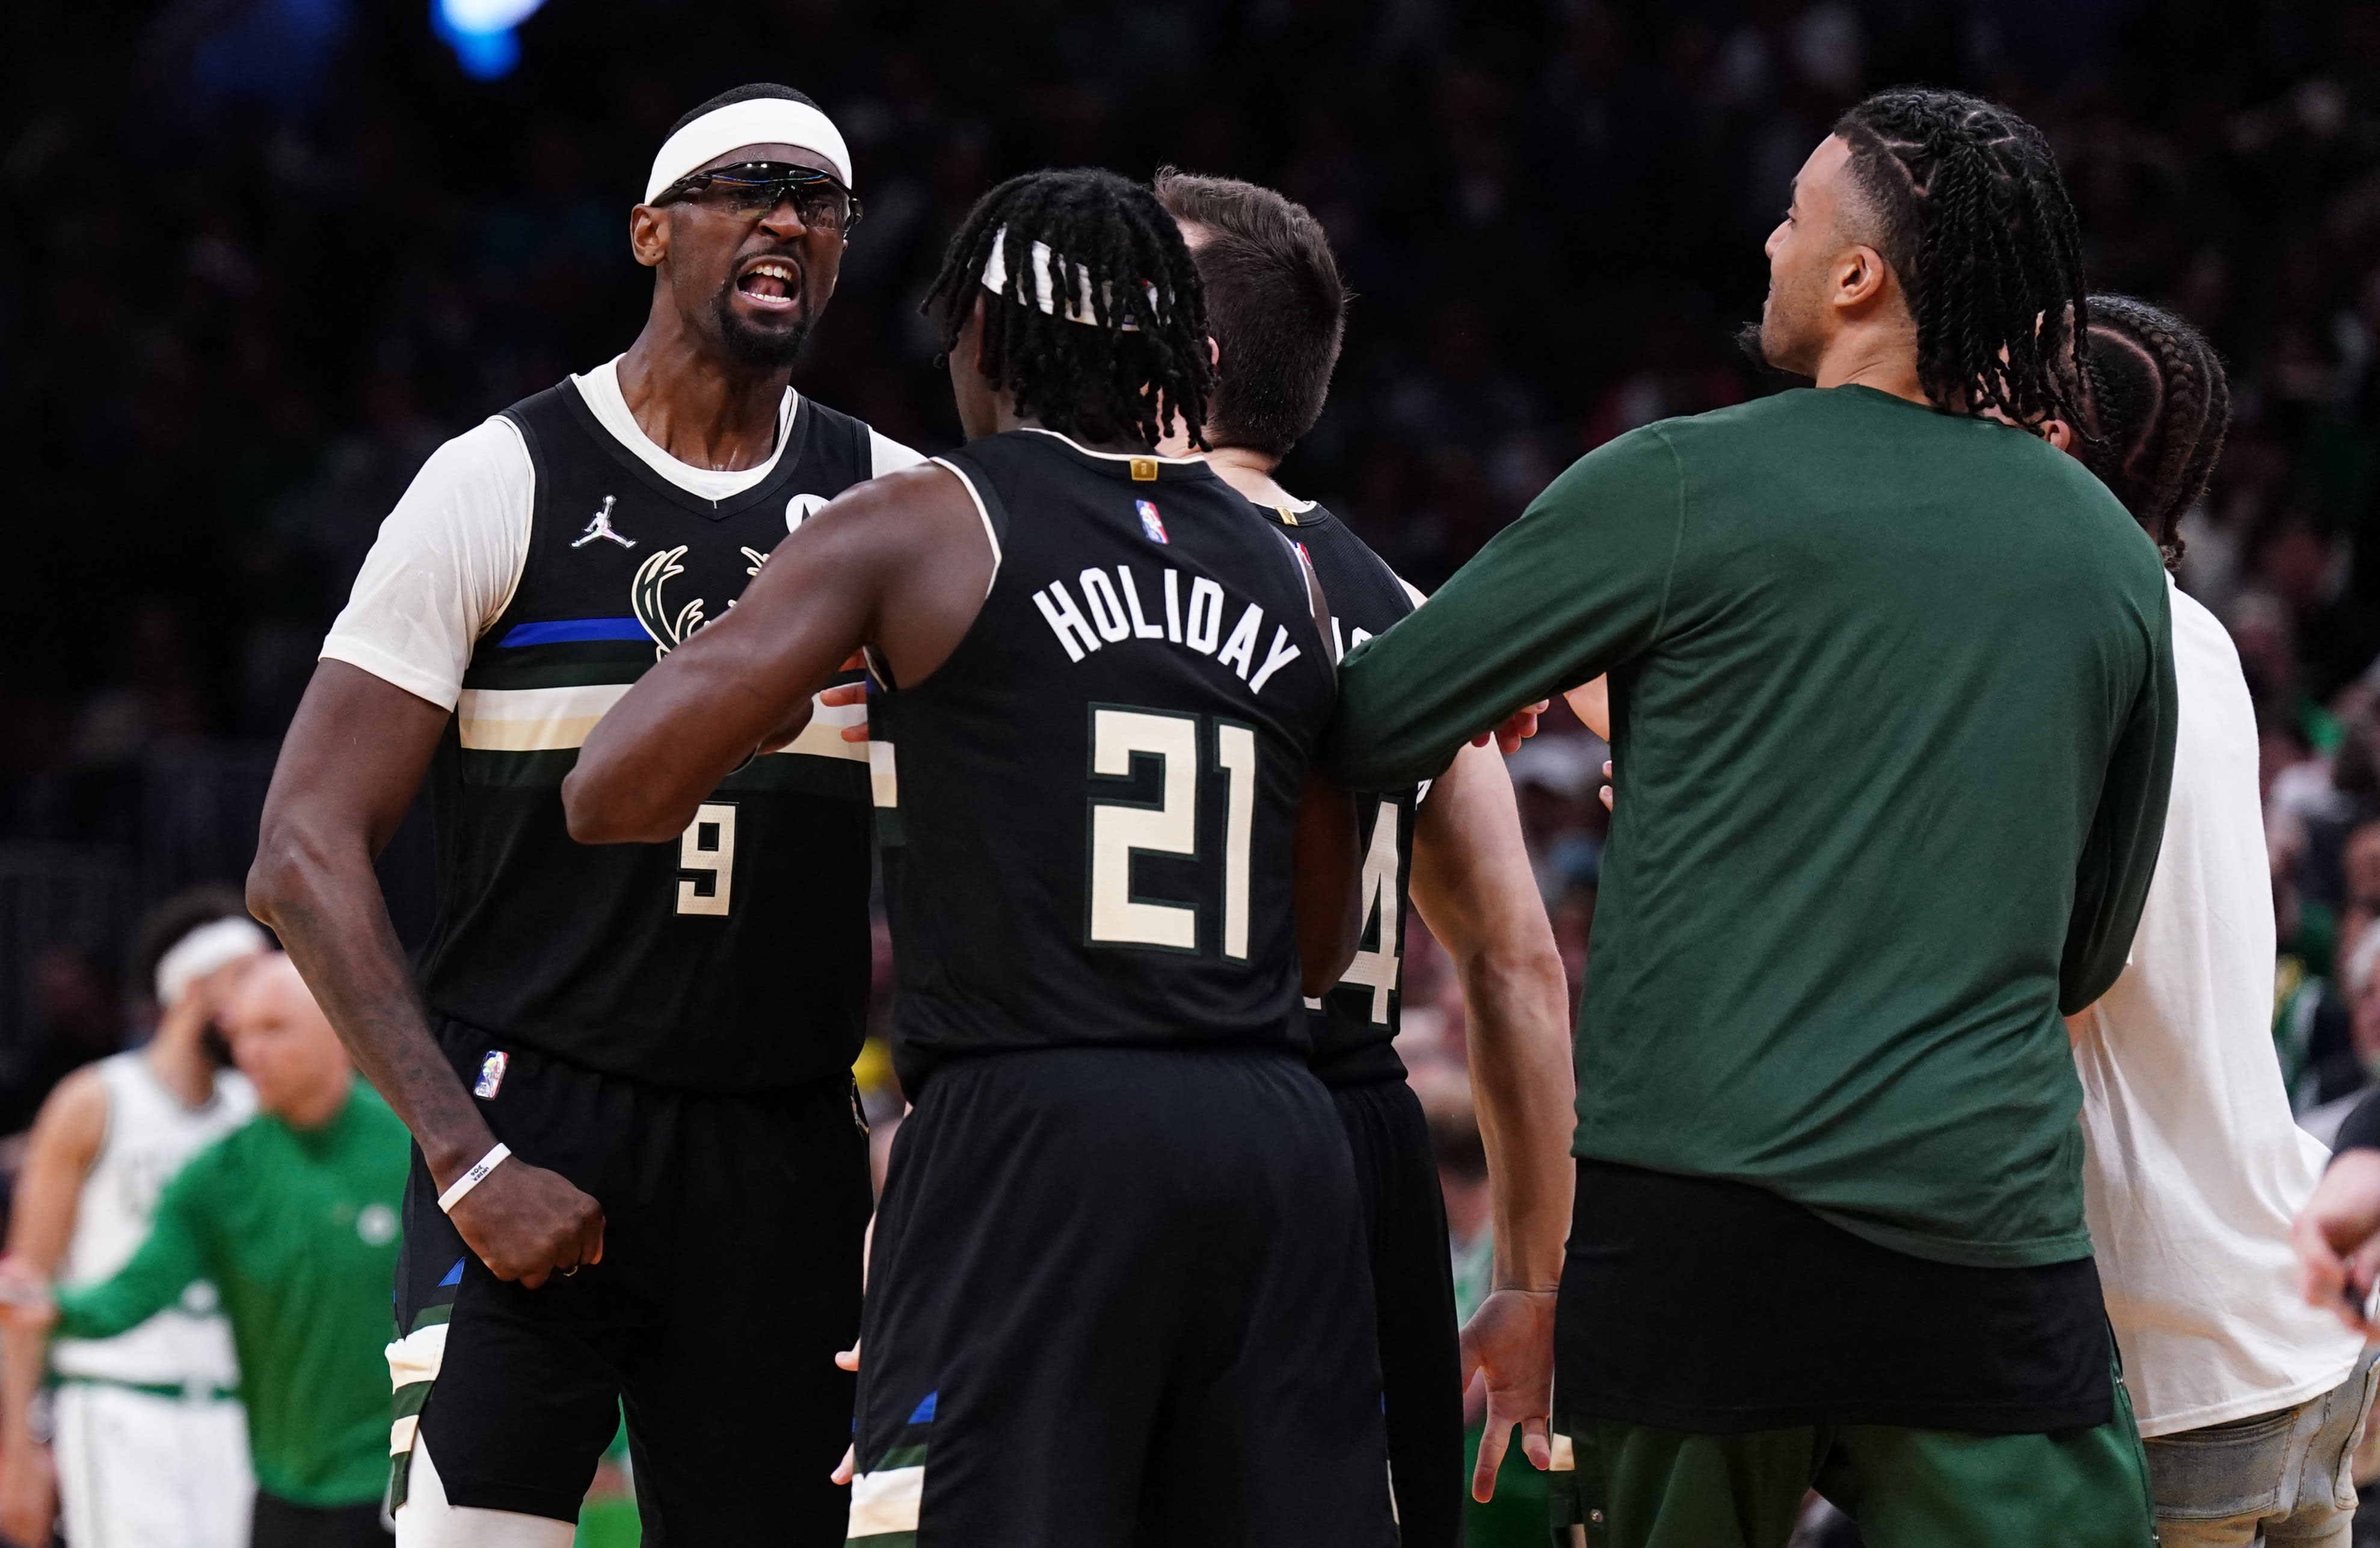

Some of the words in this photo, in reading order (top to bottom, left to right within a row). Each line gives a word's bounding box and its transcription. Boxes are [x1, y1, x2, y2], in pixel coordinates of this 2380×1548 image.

[1032, 565, 1302, 695] HOLIDAY
[676, 803, 736, 916] 9
[1090, 708, 1256, 960] 21
[1303, 801, 1400, 1025] 4
